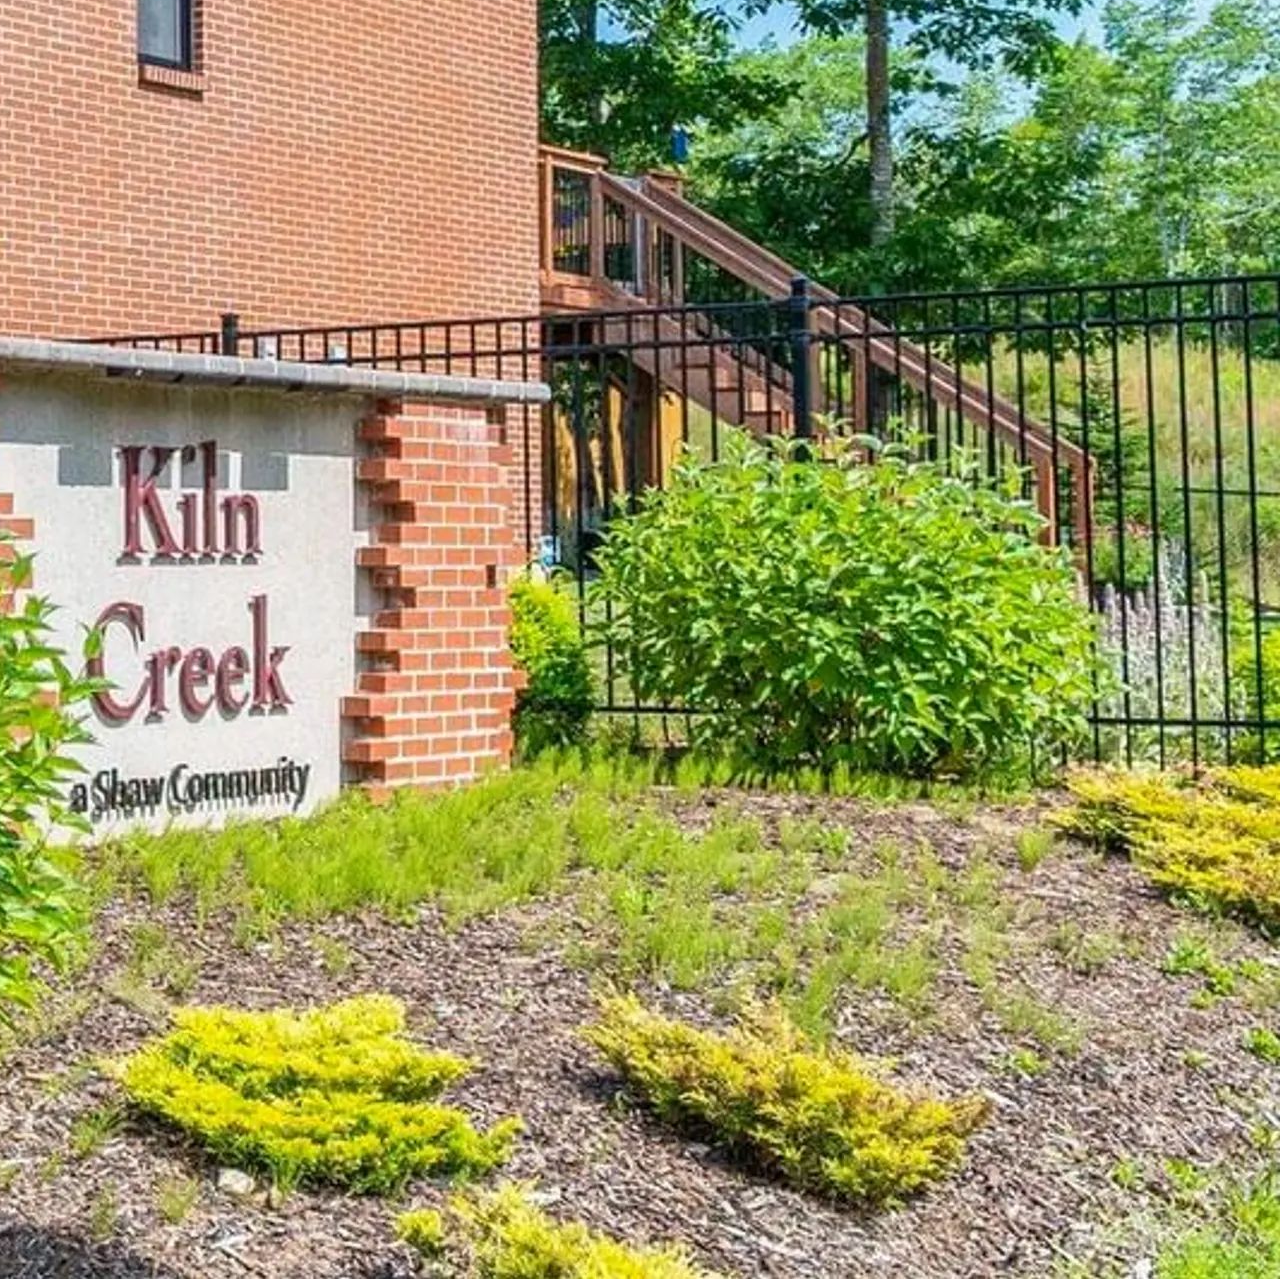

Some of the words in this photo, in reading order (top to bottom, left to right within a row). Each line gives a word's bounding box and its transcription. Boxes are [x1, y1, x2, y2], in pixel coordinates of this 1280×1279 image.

[116, 440, 264, 559] Kiln
[86, 594, 292, 724] Creek
[69, 781, 88, 813] a
[91, 767, 164, 816] Shaw
[167, 756, 310, 812] Community
